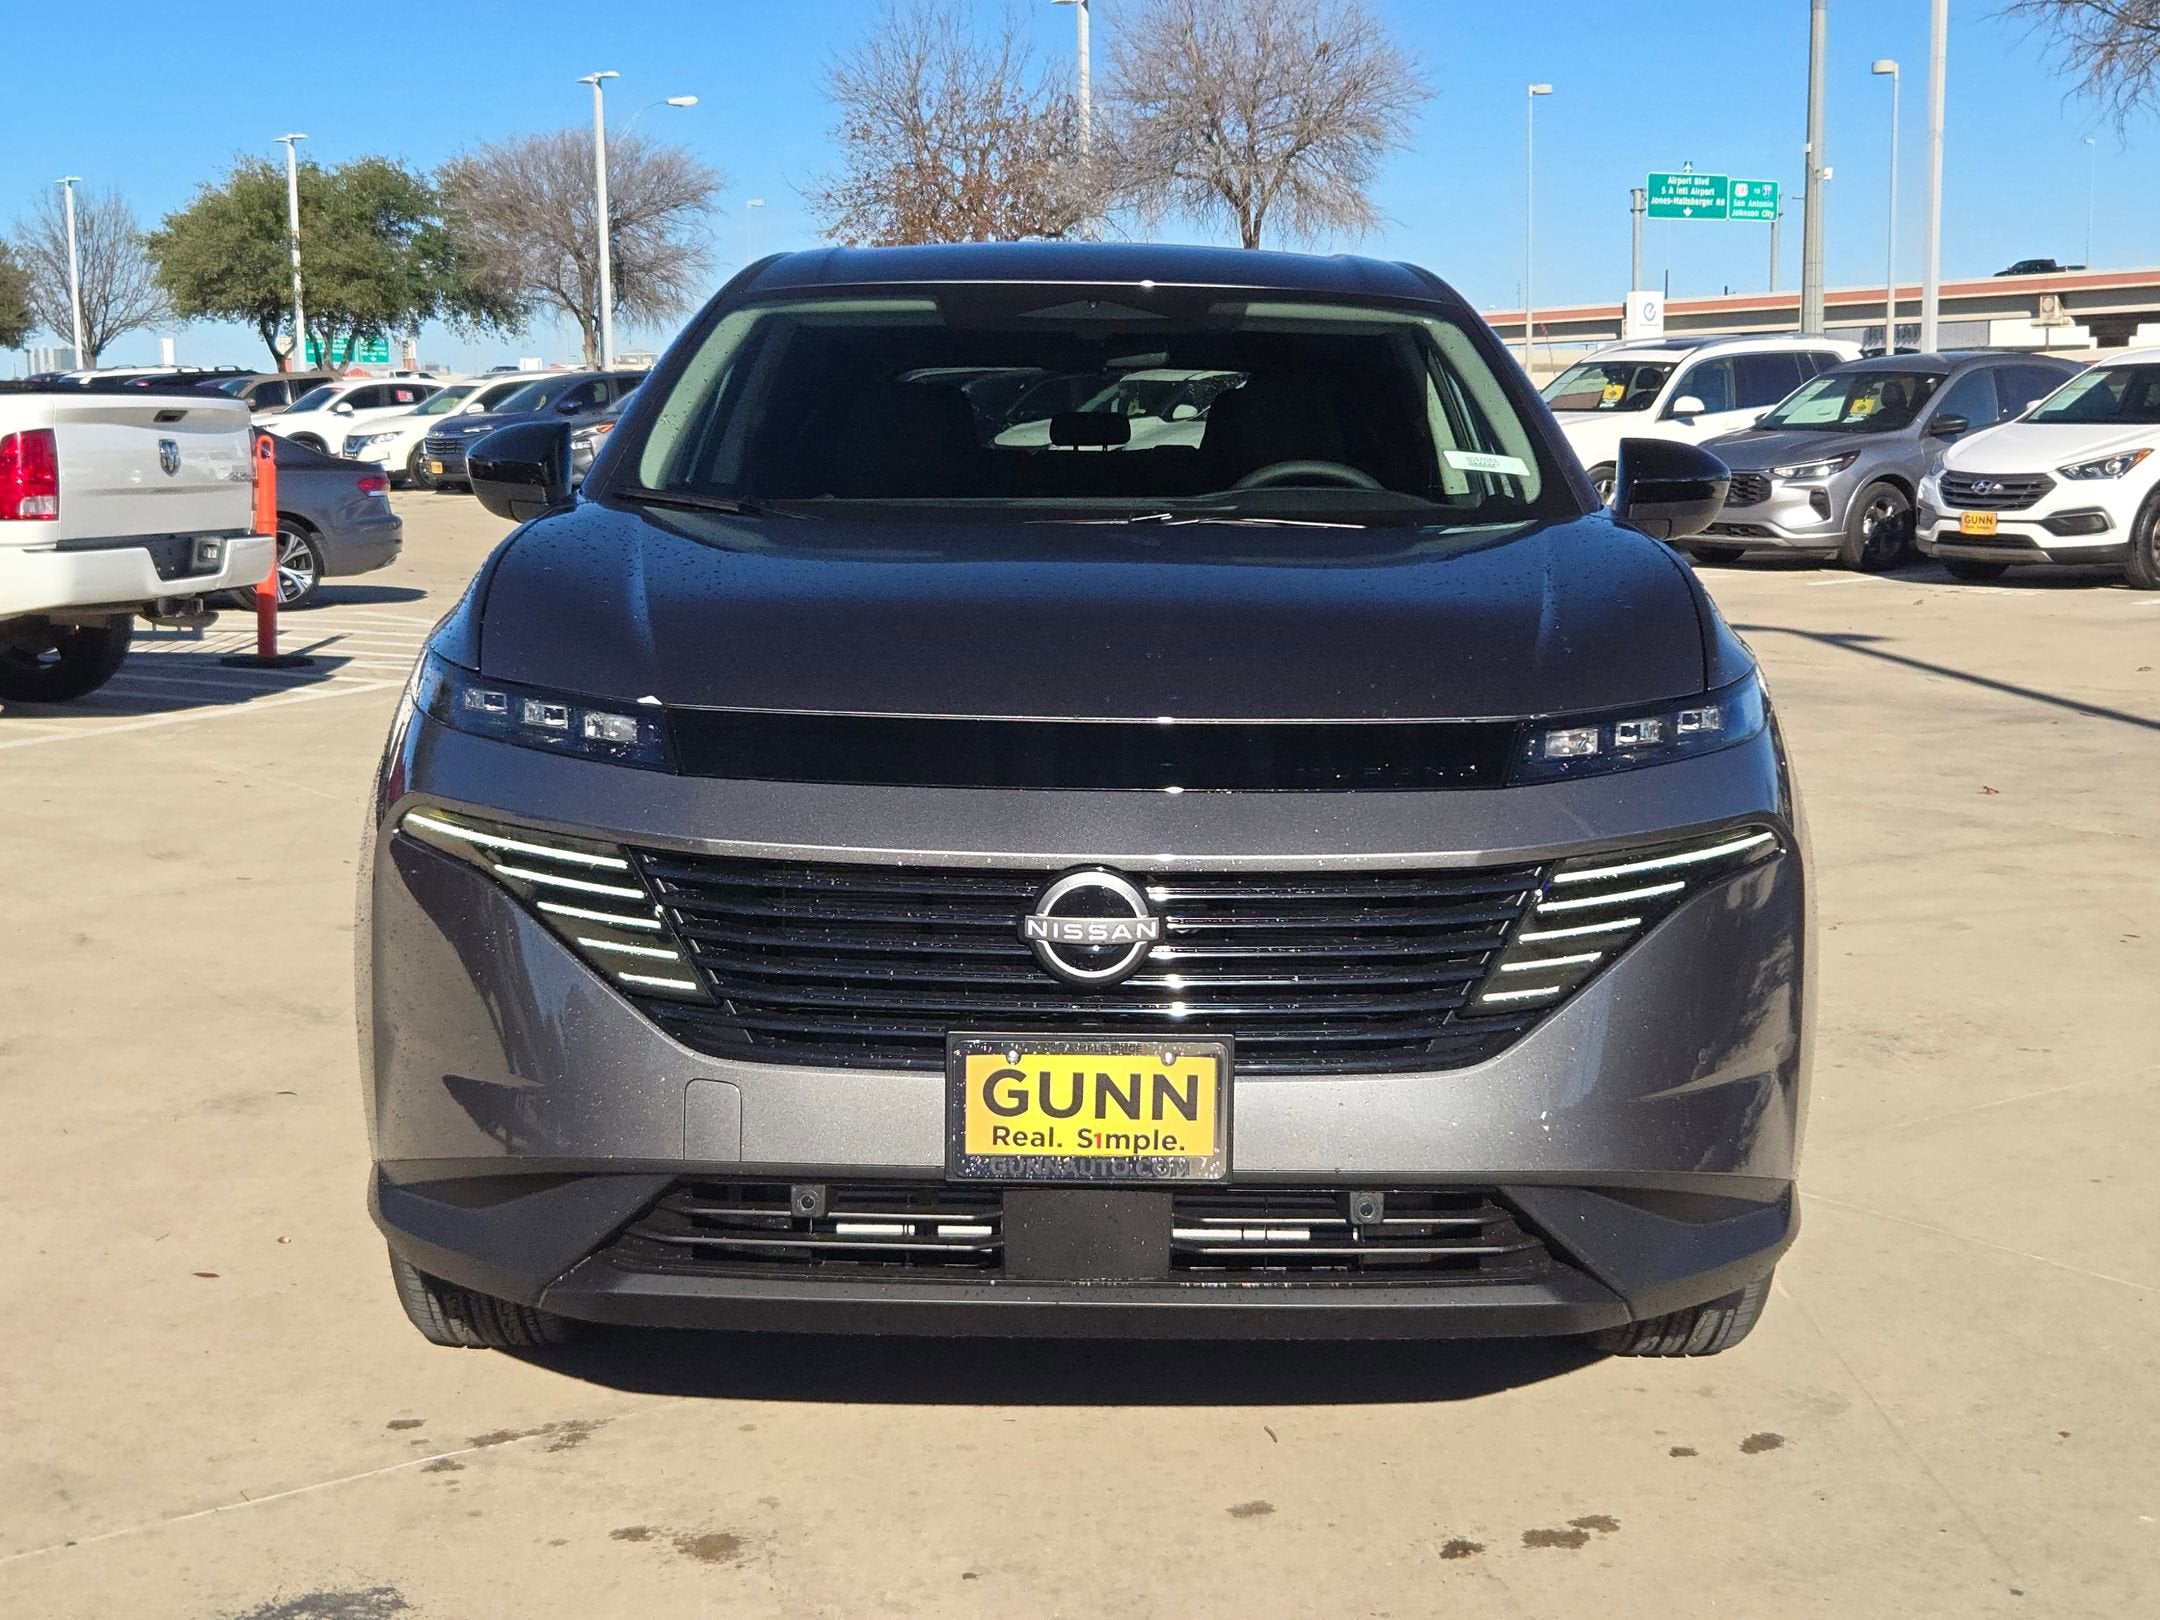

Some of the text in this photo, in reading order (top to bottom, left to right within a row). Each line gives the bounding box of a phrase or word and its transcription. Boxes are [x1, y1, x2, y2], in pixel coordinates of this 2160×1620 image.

[1668, 176, 1710, 186] Airport Blvd
[1668, 186, 1674, 194] A
[1691, 187, 1715, 197] Airport
[1733, 199, 1774, 208] San Antonio
[1731, 208, 1775, 219] Johnson City
[1964, 515, 1993, 525] GUNN
[1027, 919, 1157, 941] NISSAN
[982, 1068, 1199, 1121] GUNN
[992, 1125, 1063, 1148] Real.
[990, 1157, 1190, 1177] GUNNAUTO.COM
